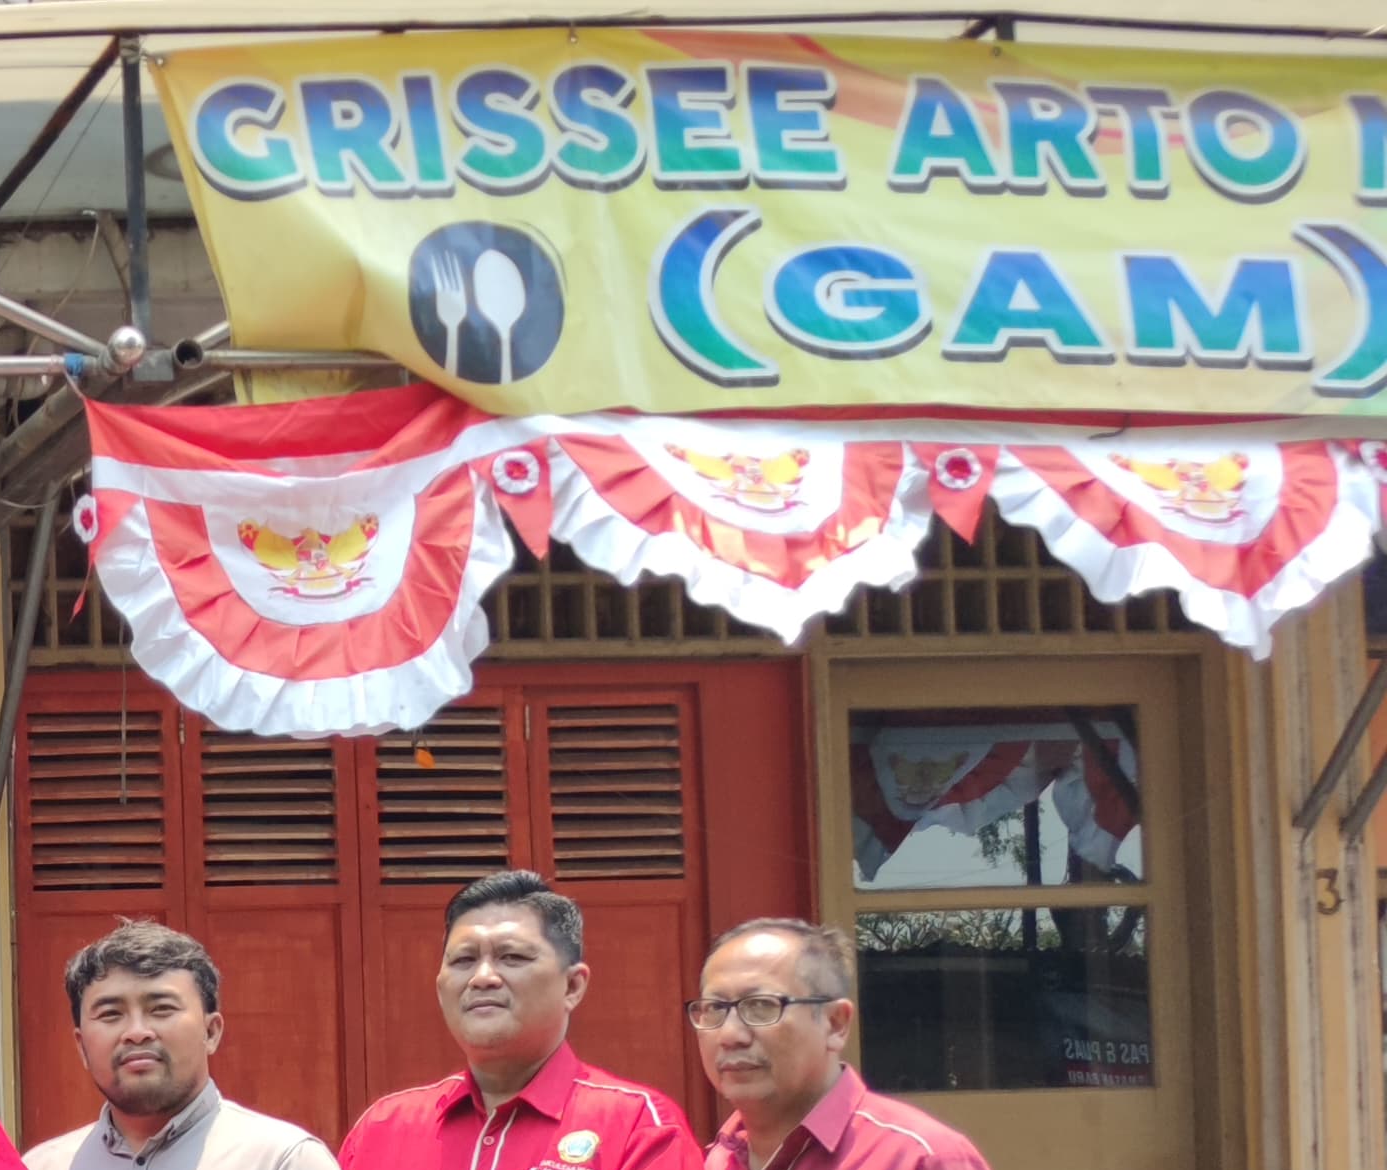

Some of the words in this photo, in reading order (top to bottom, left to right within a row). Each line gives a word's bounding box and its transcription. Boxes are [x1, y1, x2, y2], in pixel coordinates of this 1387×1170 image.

[190, 60, 847, 200] GRISSEE
[887, 74, 1309, 204] ARTO
[649, 205, 1387, 400] (GAM)
